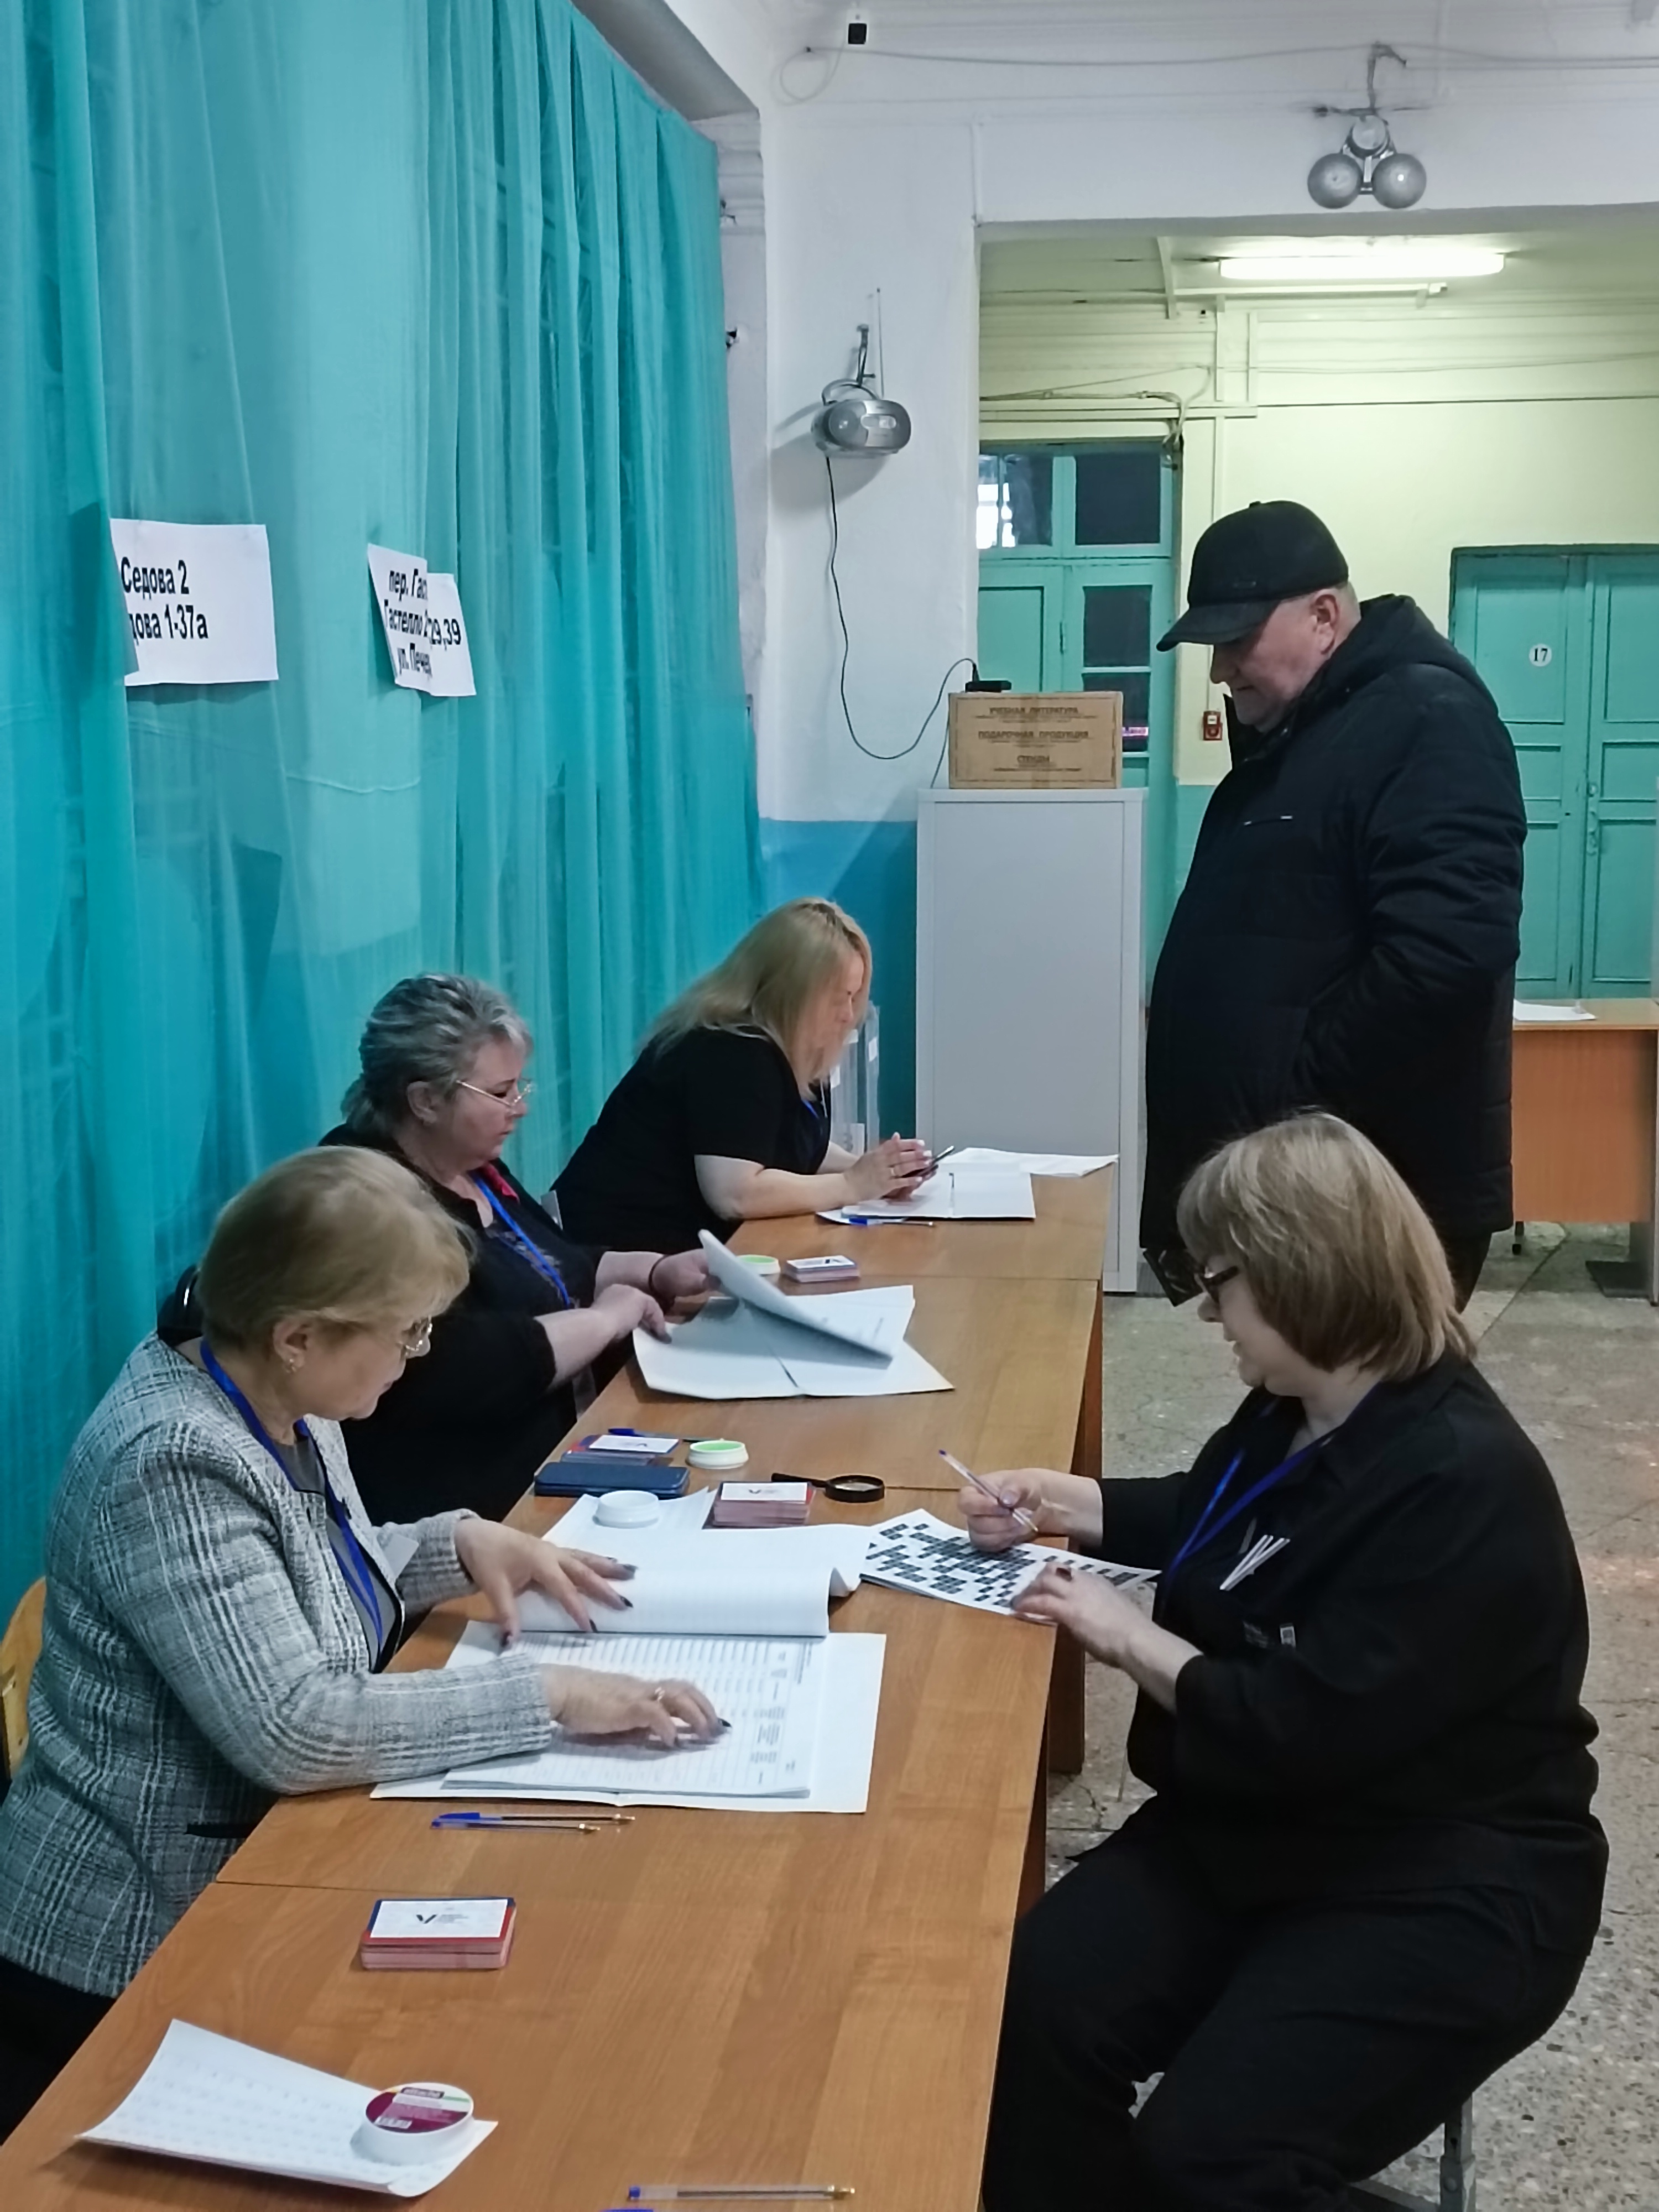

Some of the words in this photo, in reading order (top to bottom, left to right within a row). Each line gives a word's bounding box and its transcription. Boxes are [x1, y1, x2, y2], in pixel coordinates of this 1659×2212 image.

[121, 556, 176, 600] Седова
[178, 560, 190, 594] 2
[389, 570, 408, 601] пер.
[164, 603, 208, 639] 1-37а
[1534, 648, 1548, 662] 17
